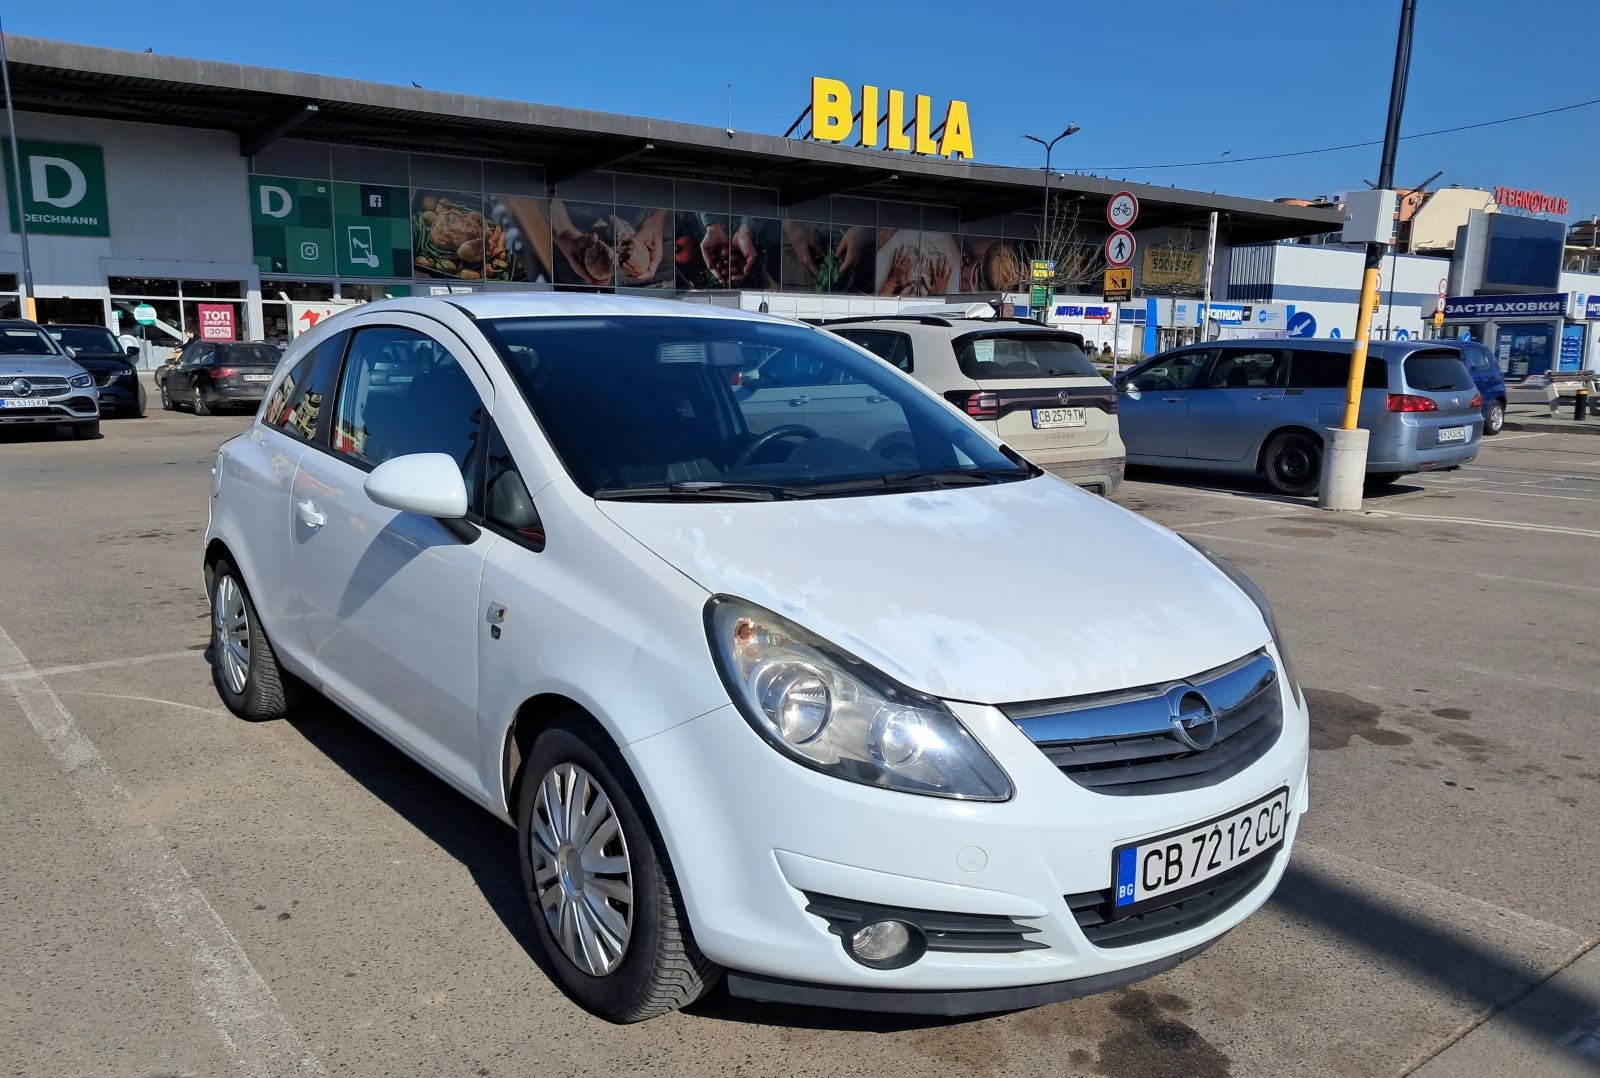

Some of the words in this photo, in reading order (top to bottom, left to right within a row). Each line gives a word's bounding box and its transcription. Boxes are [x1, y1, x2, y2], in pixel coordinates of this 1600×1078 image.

[811, 76, 974, 159] BILLA
[29, 155, 87, 208] D
[1494, 186, 1568, 215] TECHNOPOLIS
[24, 213, 98, 226] DEICHMANN
[203, 310, 231, 321] ТОП
[1445, 302, 1560, 314] ЗАСТРАХОВКИ
[1039, 410, 1051, 423] CB
[1052, 409, 1072, 422] 2579
[1142, 843, 1183, 892] CB
[1191, 816, 1253, 878] 7212
[1255, 800, 1283, 847] CC
[1119, 883, 1134, 899] BG
